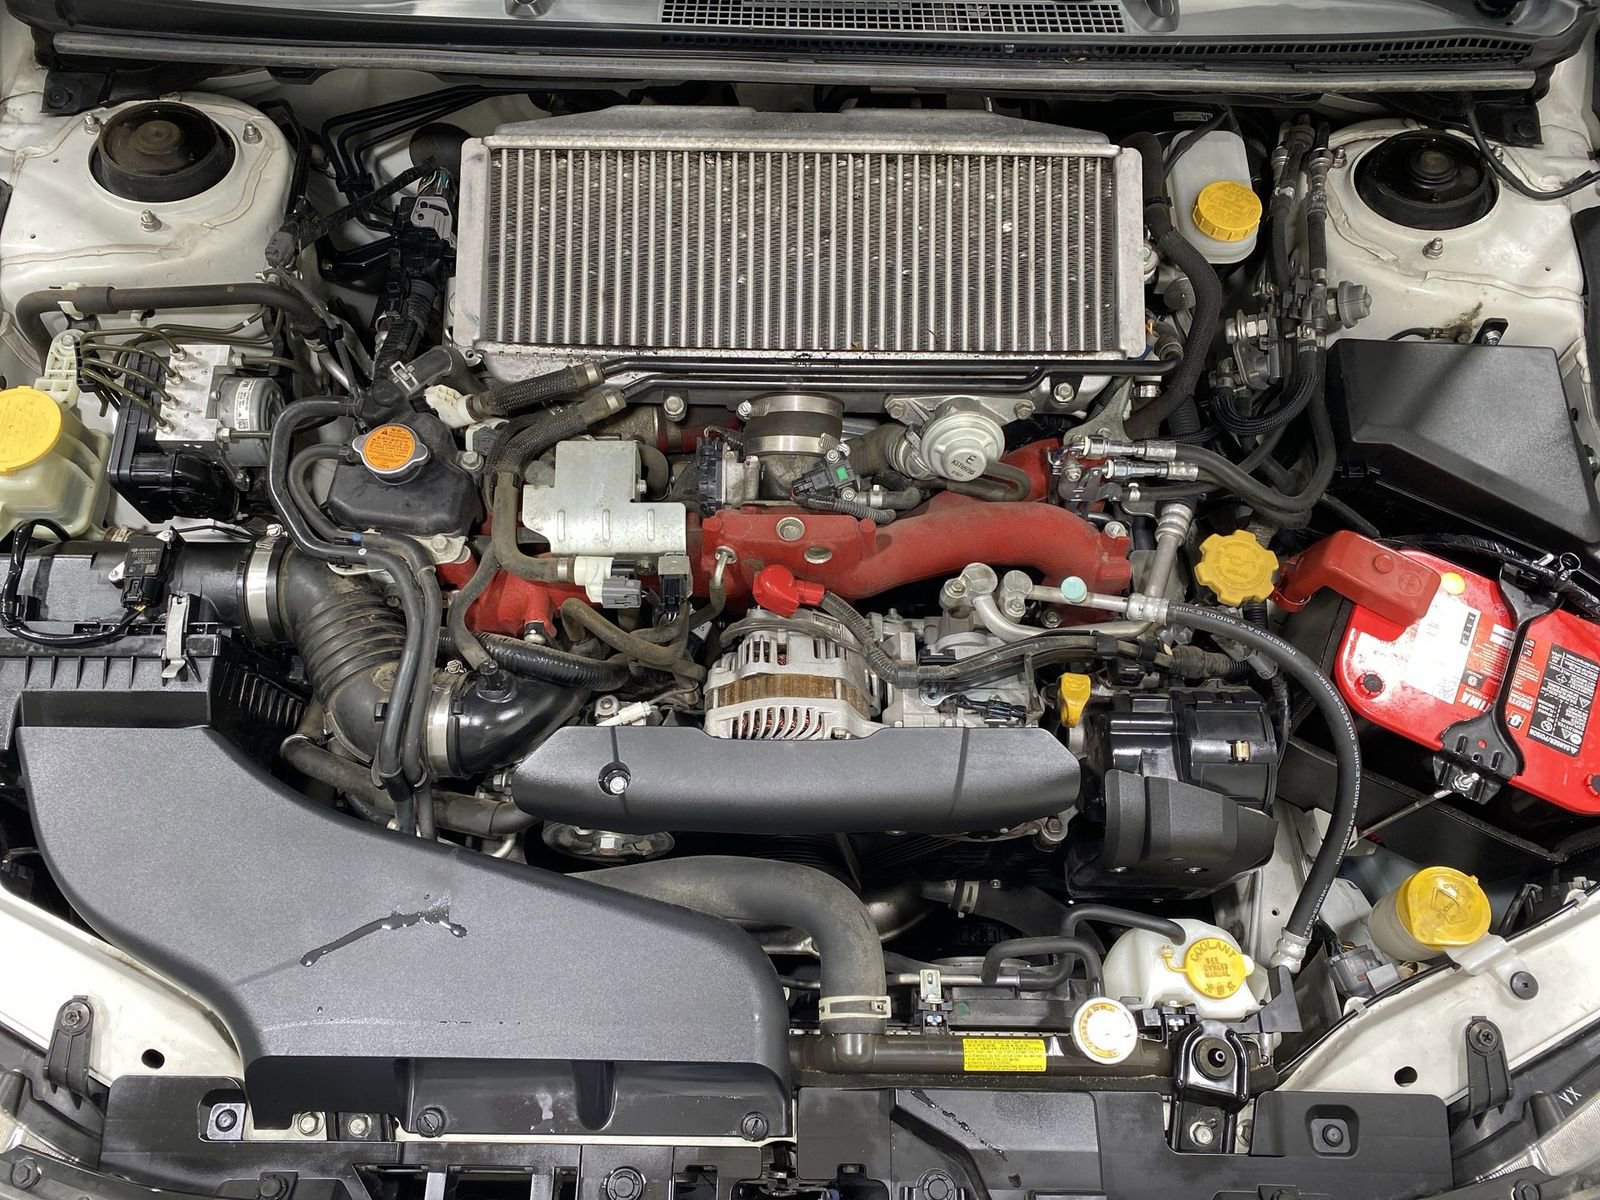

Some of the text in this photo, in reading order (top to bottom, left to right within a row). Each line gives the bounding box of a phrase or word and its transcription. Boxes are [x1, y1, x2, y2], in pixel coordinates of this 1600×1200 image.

[966, 455, 977, 465] E
[1190, 941, 1237, 961] COOLANT
[1558, 1086, 1582, 1106] VX
